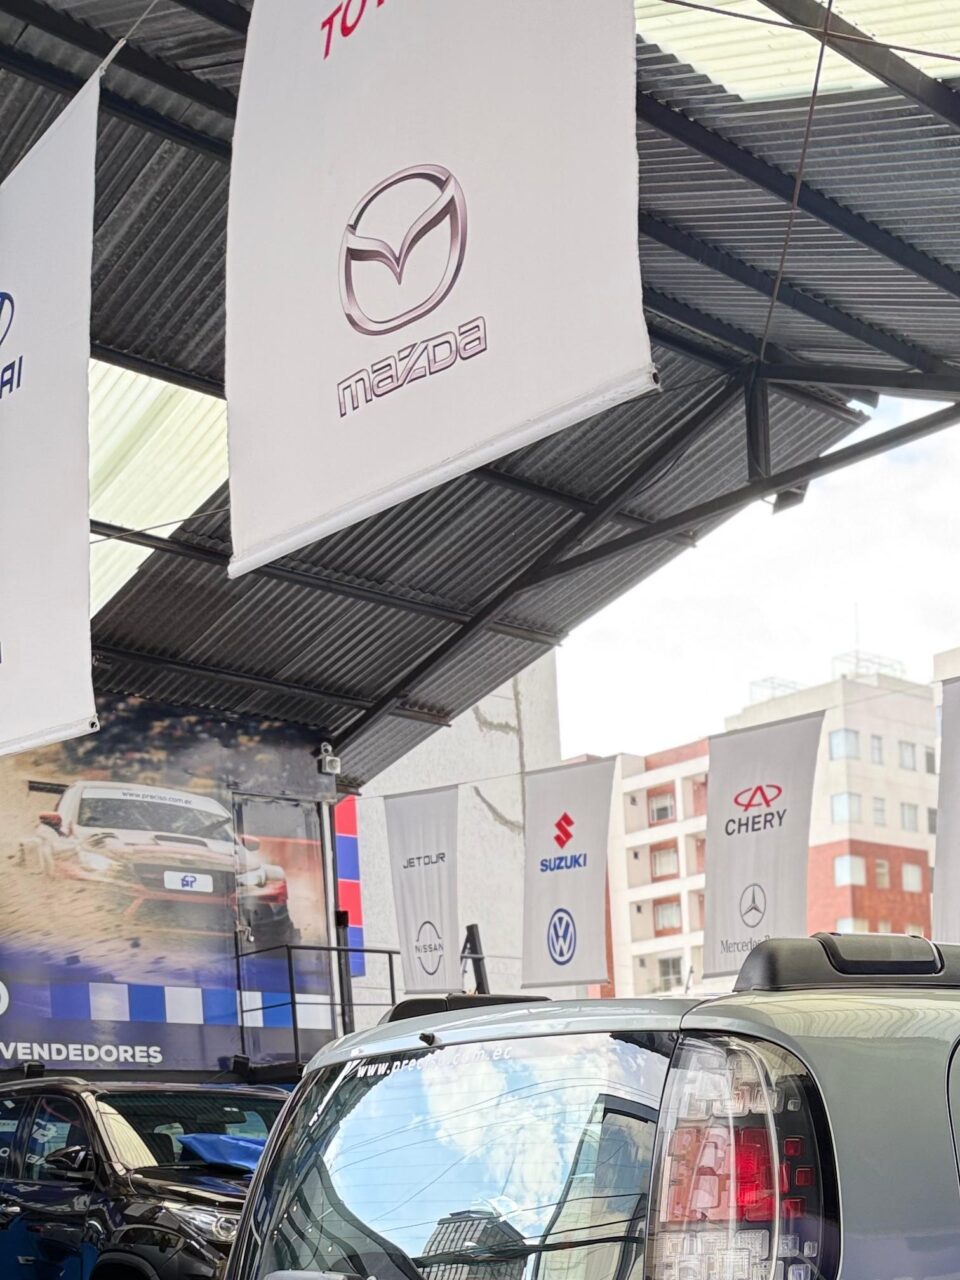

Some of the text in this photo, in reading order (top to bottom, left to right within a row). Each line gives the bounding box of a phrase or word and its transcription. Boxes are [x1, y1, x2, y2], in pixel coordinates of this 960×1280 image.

[320, 0, 385, 60] TO
[725, 809, 787, 836] CHERY
[403, 852, 446, 869] JETOUR
[540, 853, 587, 872] SUZUKI
[415, 943, 444, 954] NISSAN
[0, 1042, 163, 1063] VENDEDORES
